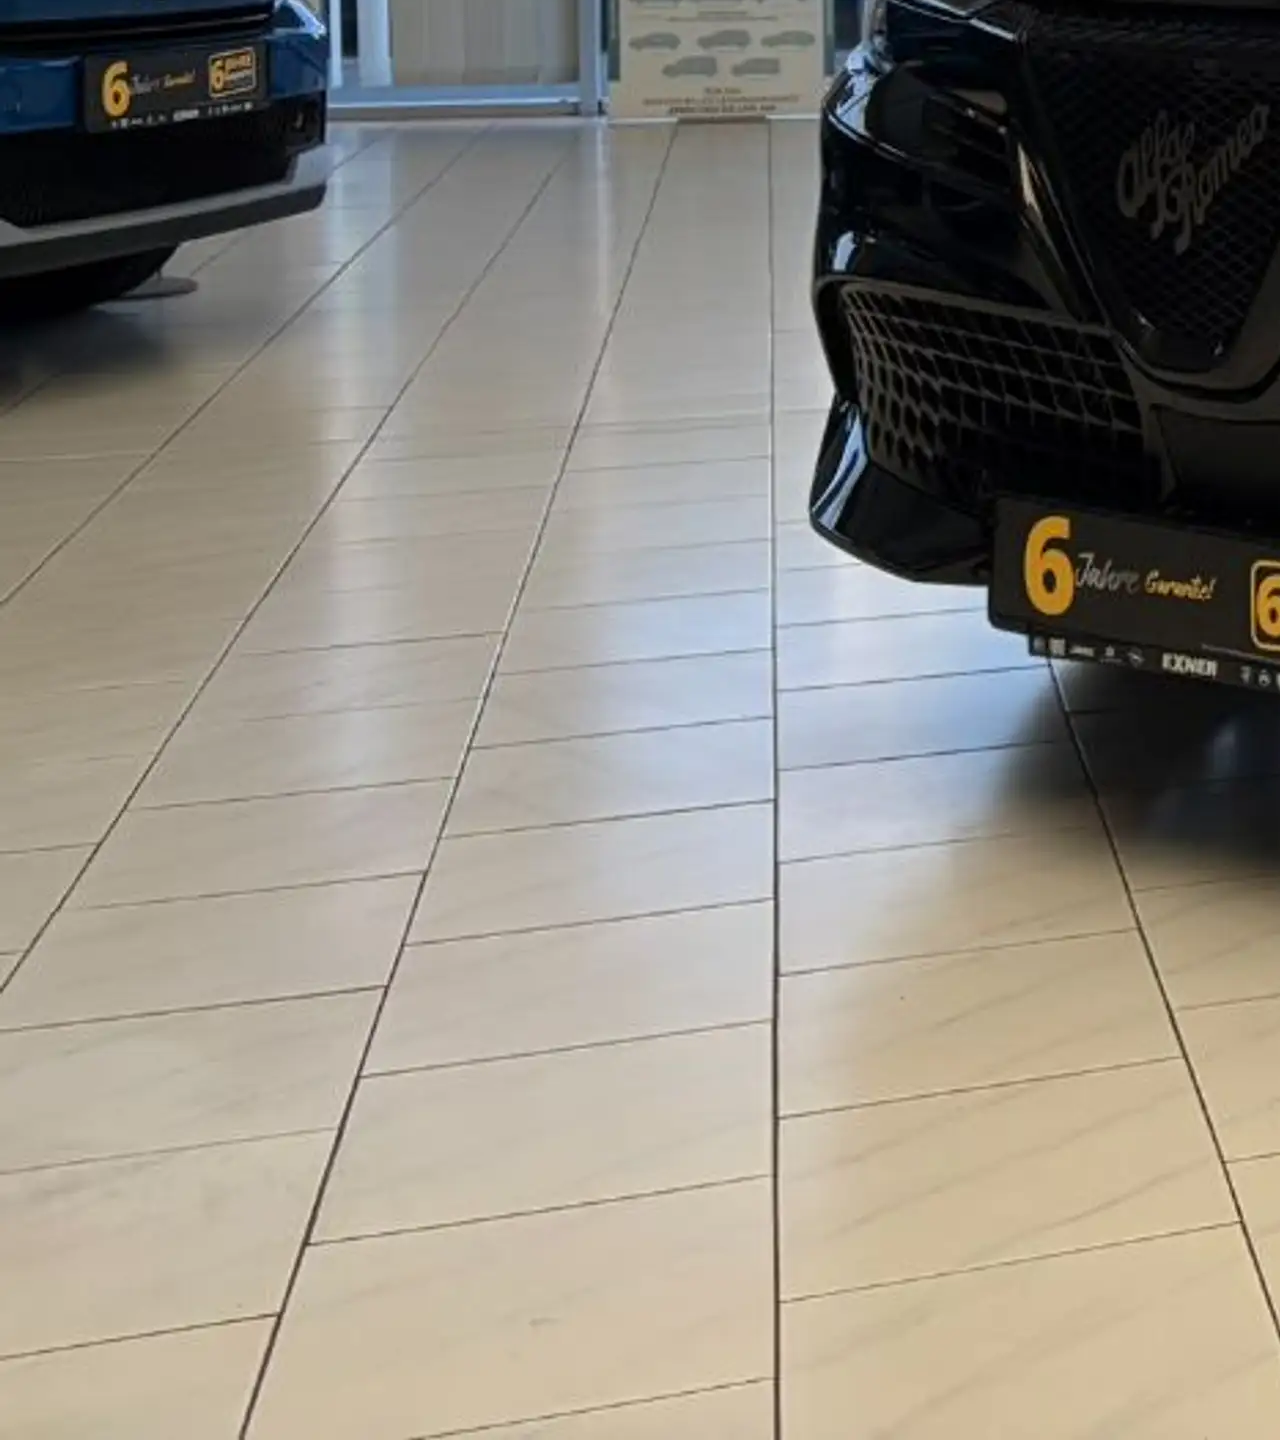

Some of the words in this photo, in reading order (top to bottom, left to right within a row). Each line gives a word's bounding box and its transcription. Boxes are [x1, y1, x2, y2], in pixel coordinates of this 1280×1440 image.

[102, 60, 131, 117] 6
[1025, 515, 1075, 616] 6
[1076, 552, 1140, 595] Jahre
